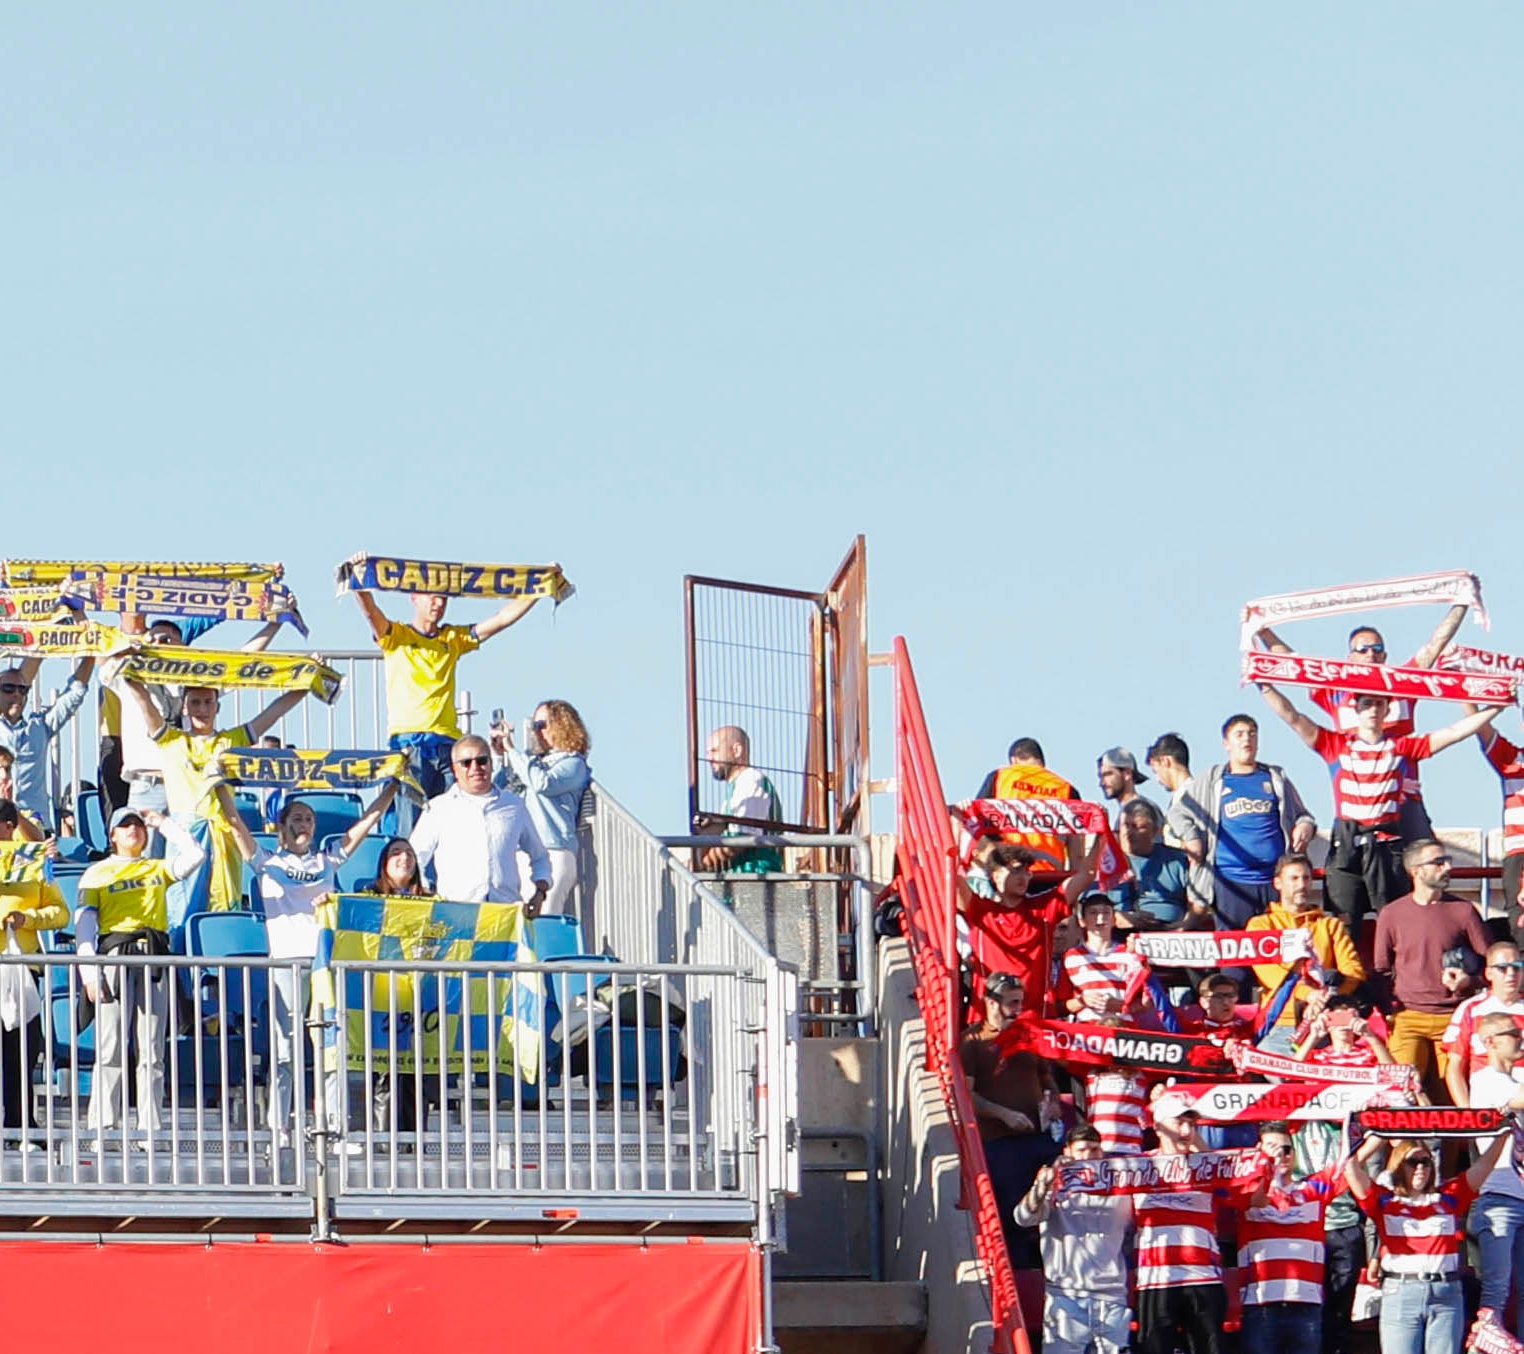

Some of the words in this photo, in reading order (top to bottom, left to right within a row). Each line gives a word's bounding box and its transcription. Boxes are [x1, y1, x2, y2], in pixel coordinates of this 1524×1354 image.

[133, 655, 227, 683] Somos
[237, 661, 274, 682] de
[284, 659, 315, 682] 1ª
[1226, 799, 1272, 817] wiber
[1196, 1158, 1212, 1181] de
